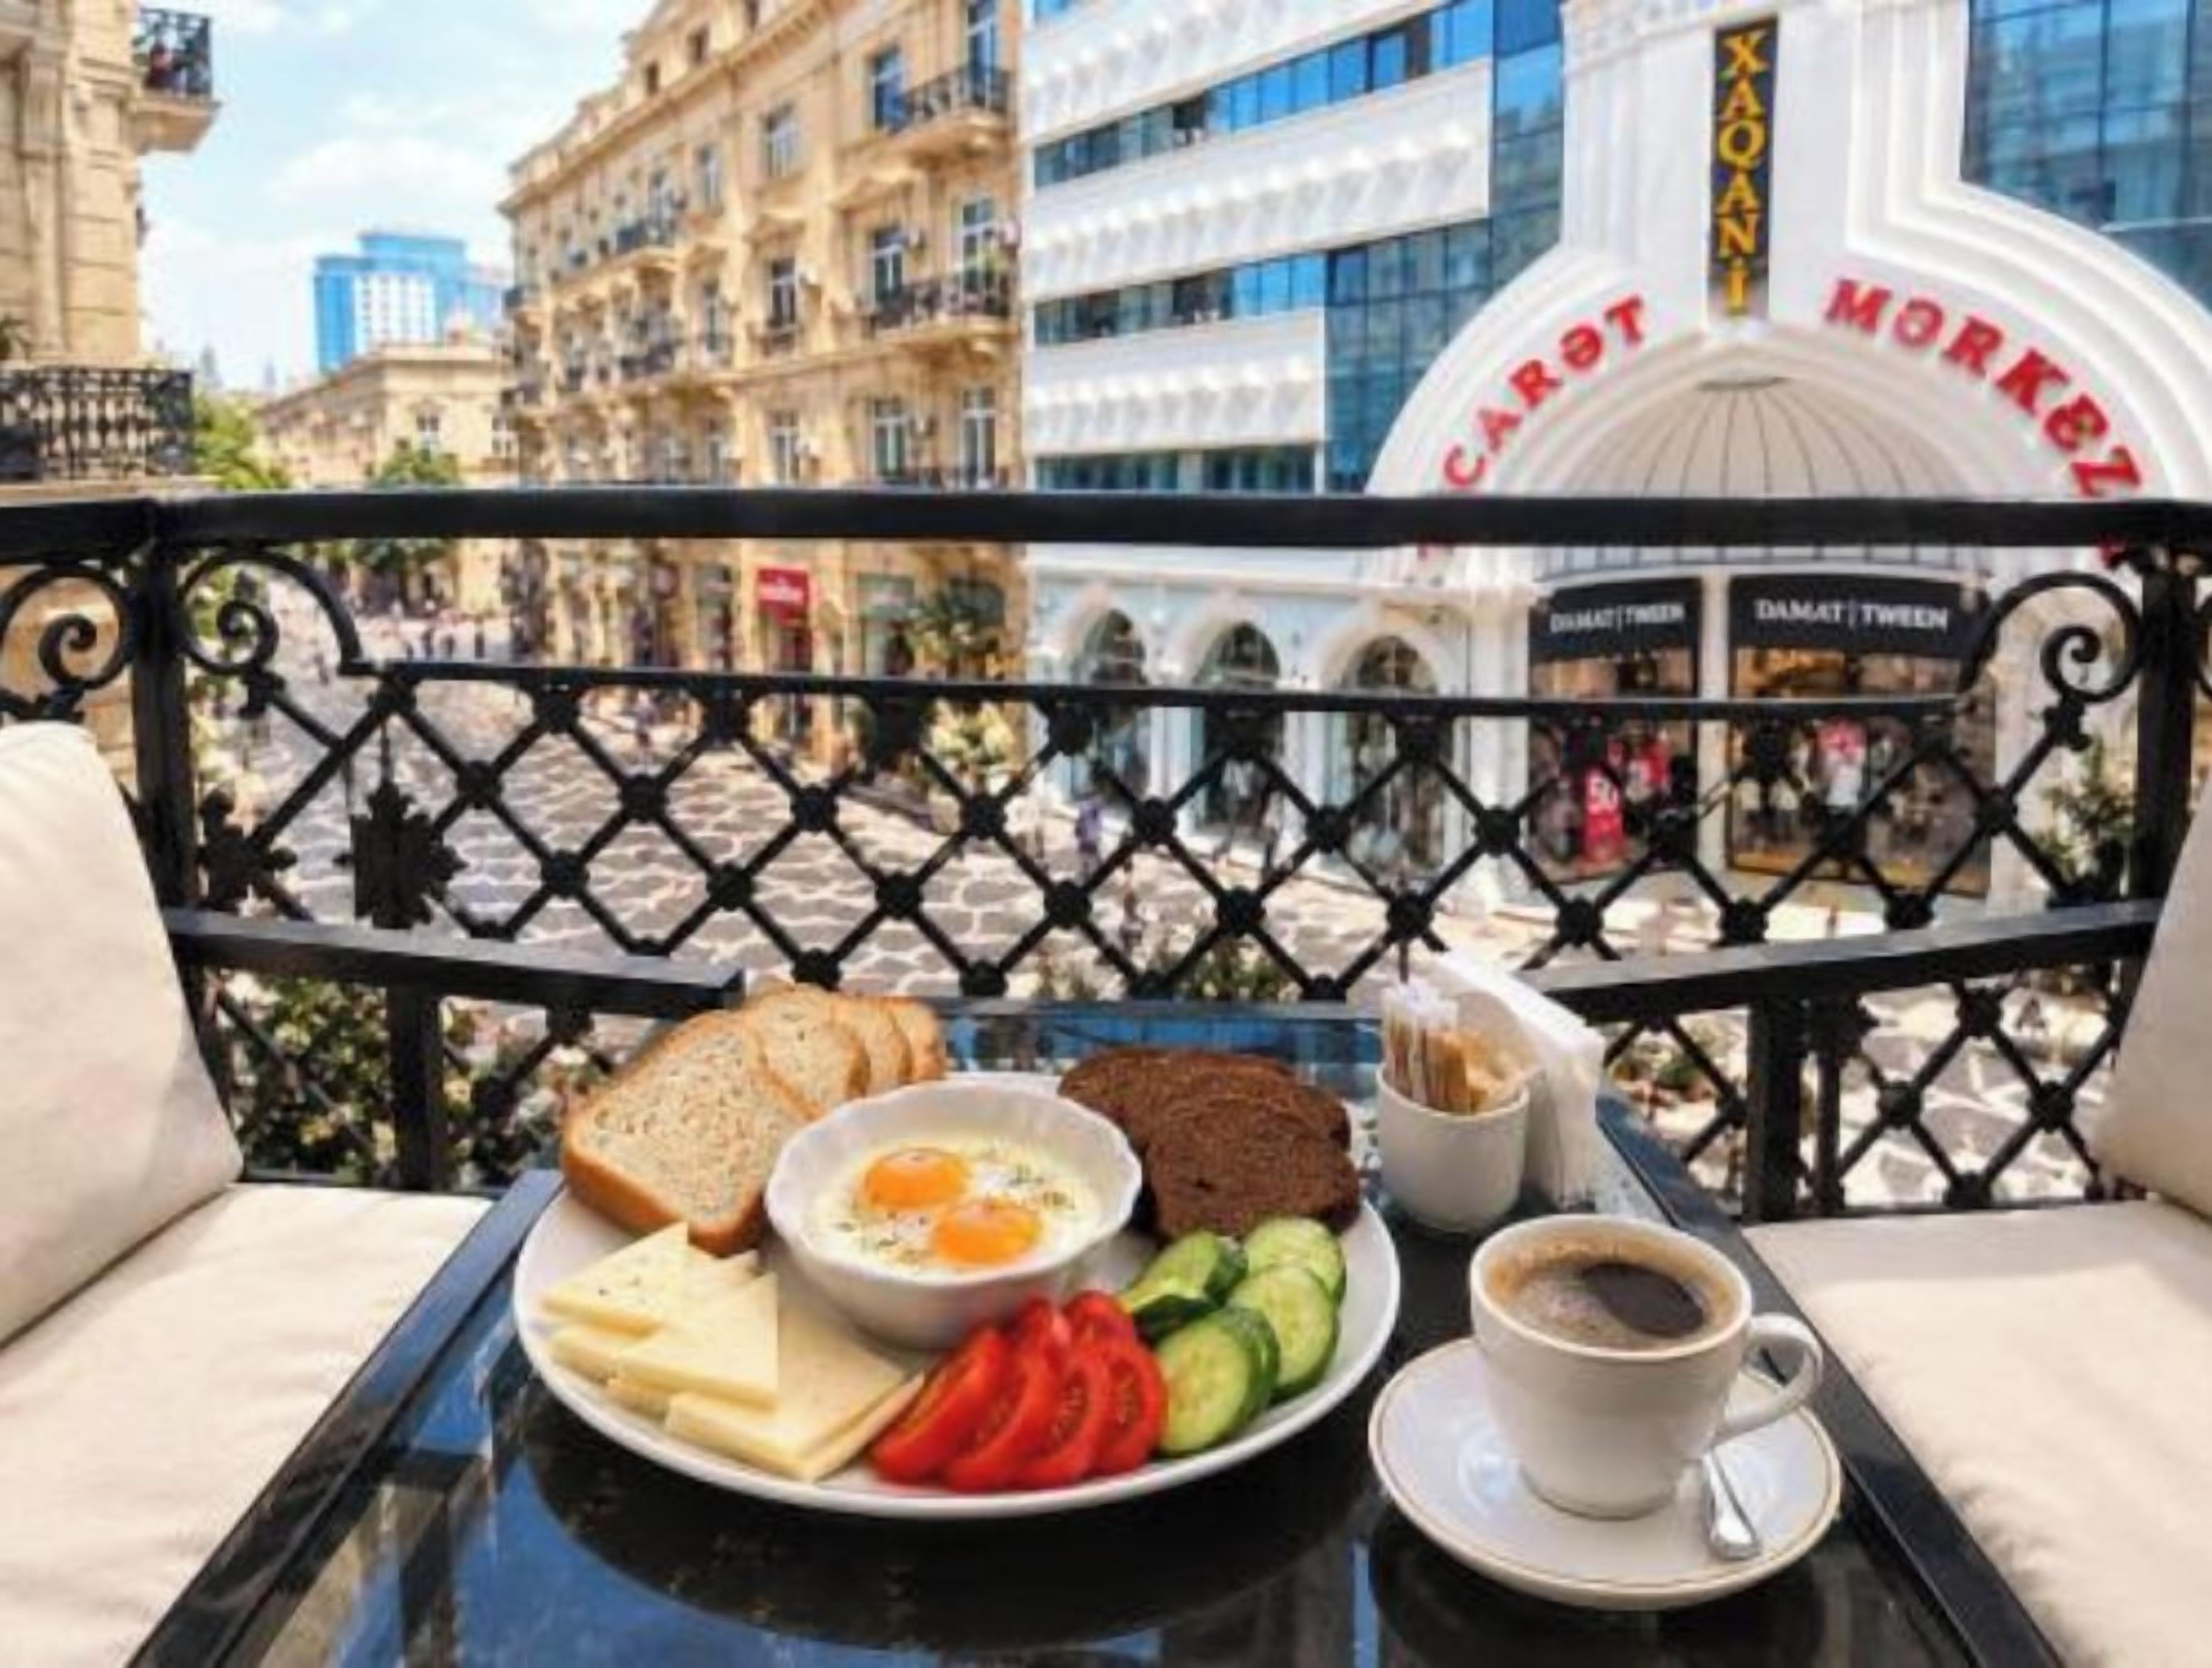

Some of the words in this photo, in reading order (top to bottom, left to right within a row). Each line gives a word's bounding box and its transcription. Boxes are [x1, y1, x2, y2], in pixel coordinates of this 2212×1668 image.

[1417, 294, 1643, 560] CARƏT
[1754, 598, 1841, 624] DAMAT
[1861, 603, 1948, 631] TWEEN
